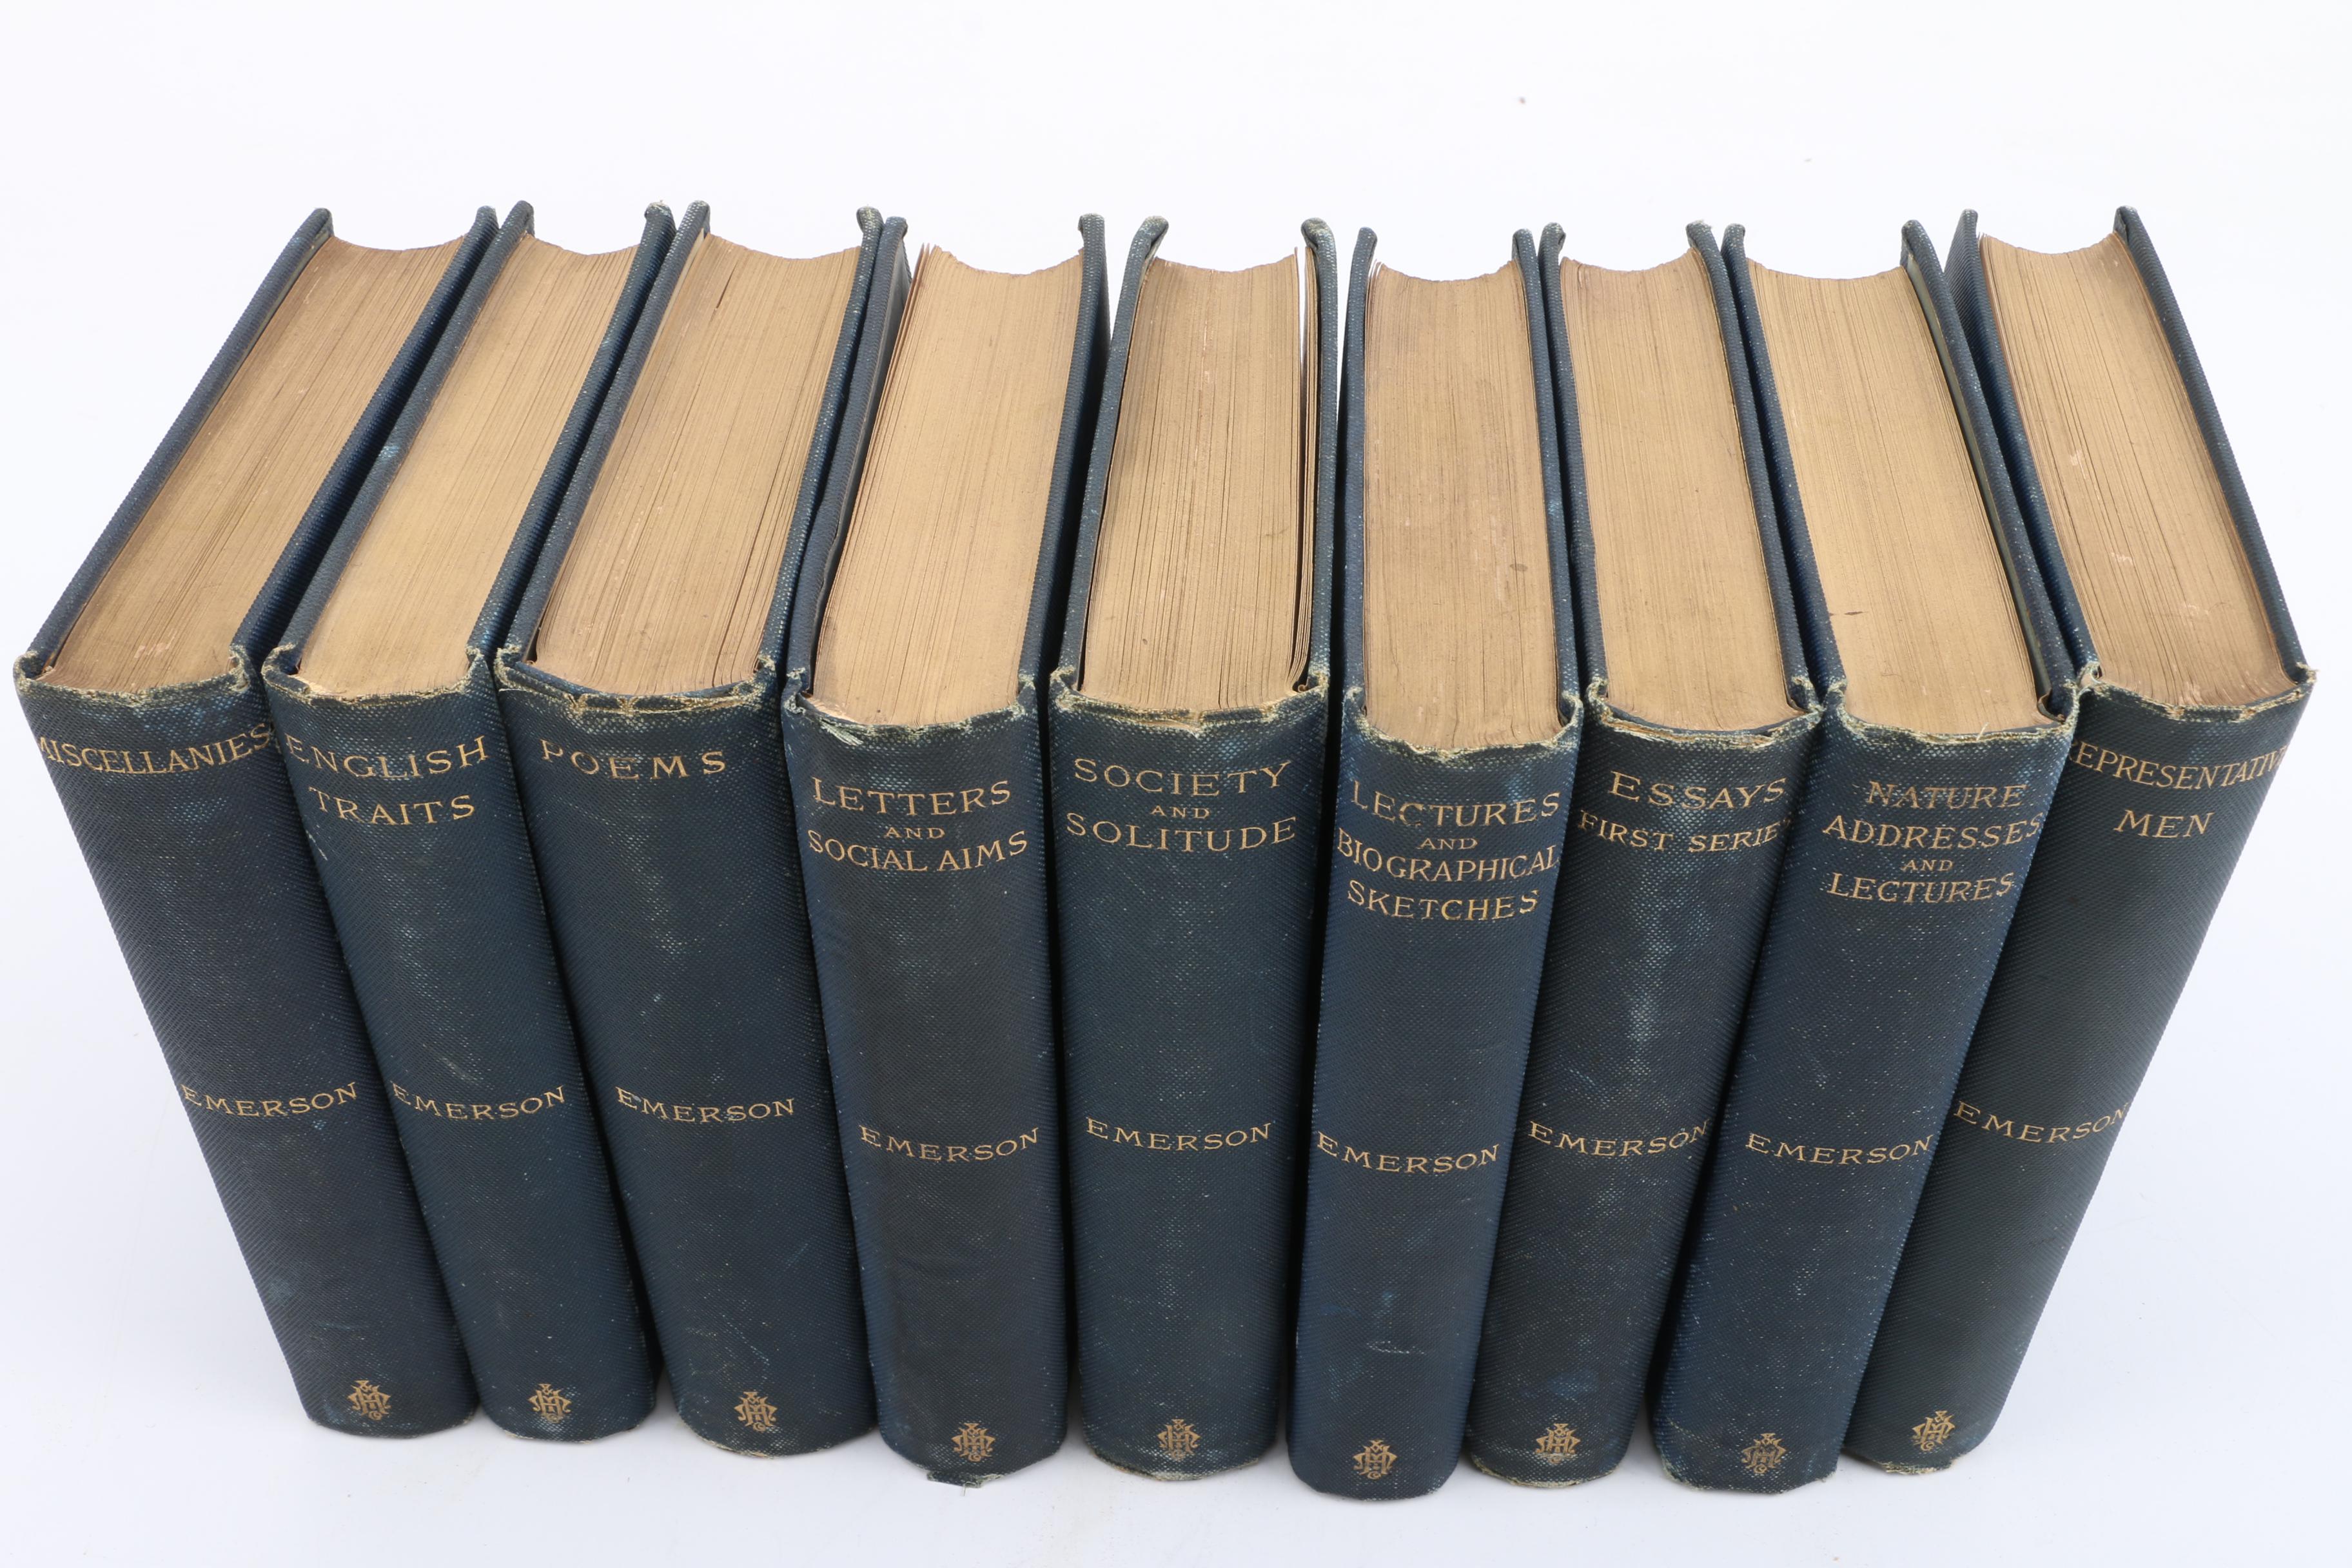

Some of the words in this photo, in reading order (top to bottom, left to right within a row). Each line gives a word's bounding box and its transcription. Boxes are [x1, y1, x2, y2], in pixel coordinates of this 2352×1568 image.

[285, 735, 489, 779] ENGLISH
[540, 739, 727, 780] POEMS
[812, 776, 1011, 816] LETTERS
[1074, 758, 1291, 797] SOCIETY
[1607, 771, 1787, 810] ESSAYS
[1867, 780, 2028, 809] NATURE
[309, 787, 476, 825] TRAITS
[1151, 807, 1210, 819] AND
[1351, 780, 1561, 827] LECTURES
[884, 827, 946, 839] AND
[1066, 812, 1297, 852] SOLITUDE
[1578, 810, 1674, 852] FIRST
[1822, 812, 2044, 850] ADDRESSES
[2113, 809, 2215, 839] MEN
[808, 830, 928, 872] SOCIAL
[937, 830, 1028, 871] AIMS
[1337, 827, 1560, 882] BIOGRAPHICAL
[1417, 838, 1478, 850] AND
[1901, 859, 1954, 872] AND
[1348, 879, 1540, 921] SKETCHES
[1827, 872, 2016, 904] LECTURES
[181, 1082, 358, 1117] EMERSON
[389, 1081, 565, 1120] EMERSON
[615, 1086, 794, 1123] EMERSON
[1086, 1117, 1272, 1152] EMERSON
[1529, 1120, 1710, 1156] EMERSON
[1953, 1101, 2128, 1144] EMERSON
[859, 1125, 1039, 1162] EMERSON
[1317, 1130, 1500, 1174] EMERSON
[1745, 1132, 1934, 1165] EMERSON
